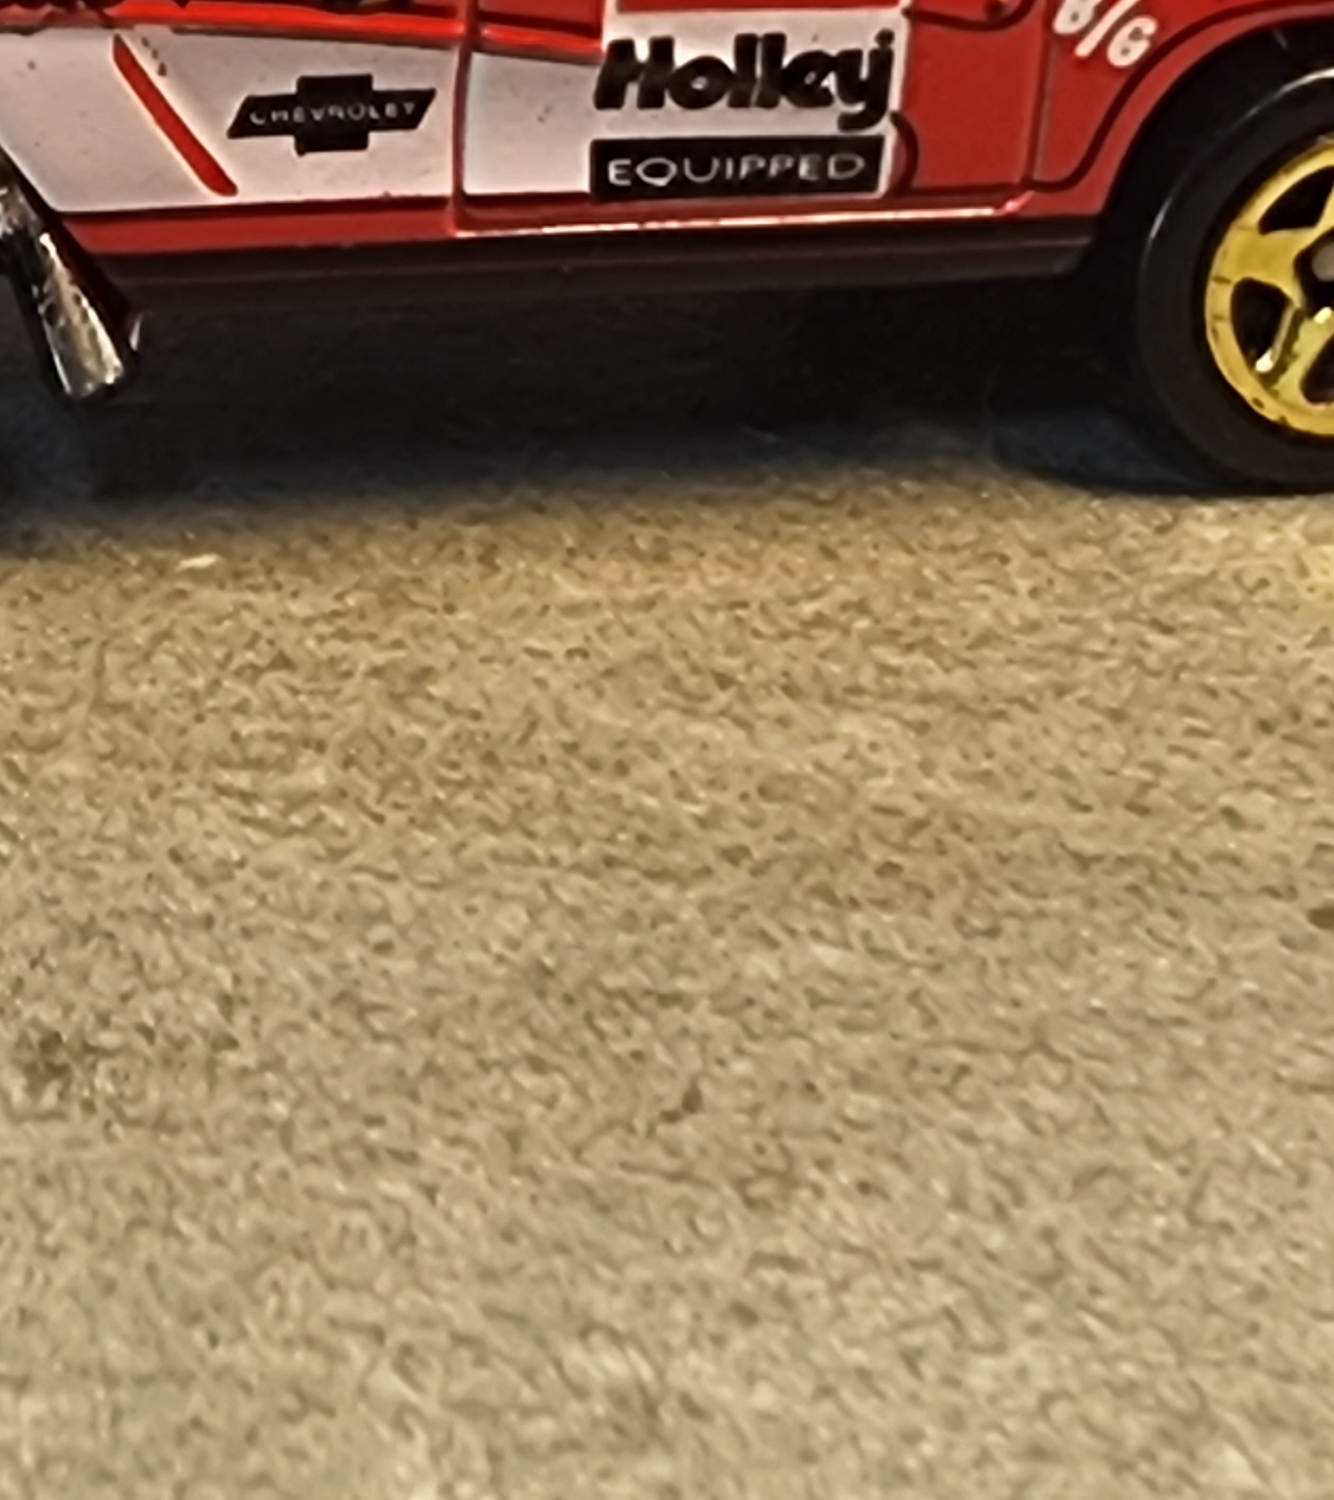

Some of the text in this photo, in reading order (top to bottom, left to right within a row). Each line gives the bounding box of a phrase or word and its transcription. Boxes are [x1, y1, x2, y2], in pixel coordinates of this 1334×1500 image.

[593, 28, 896, 133] Holley
[248, 101, 417, 126] CHEVROLET
[606, 153, 866, 188] EQUIPPED
